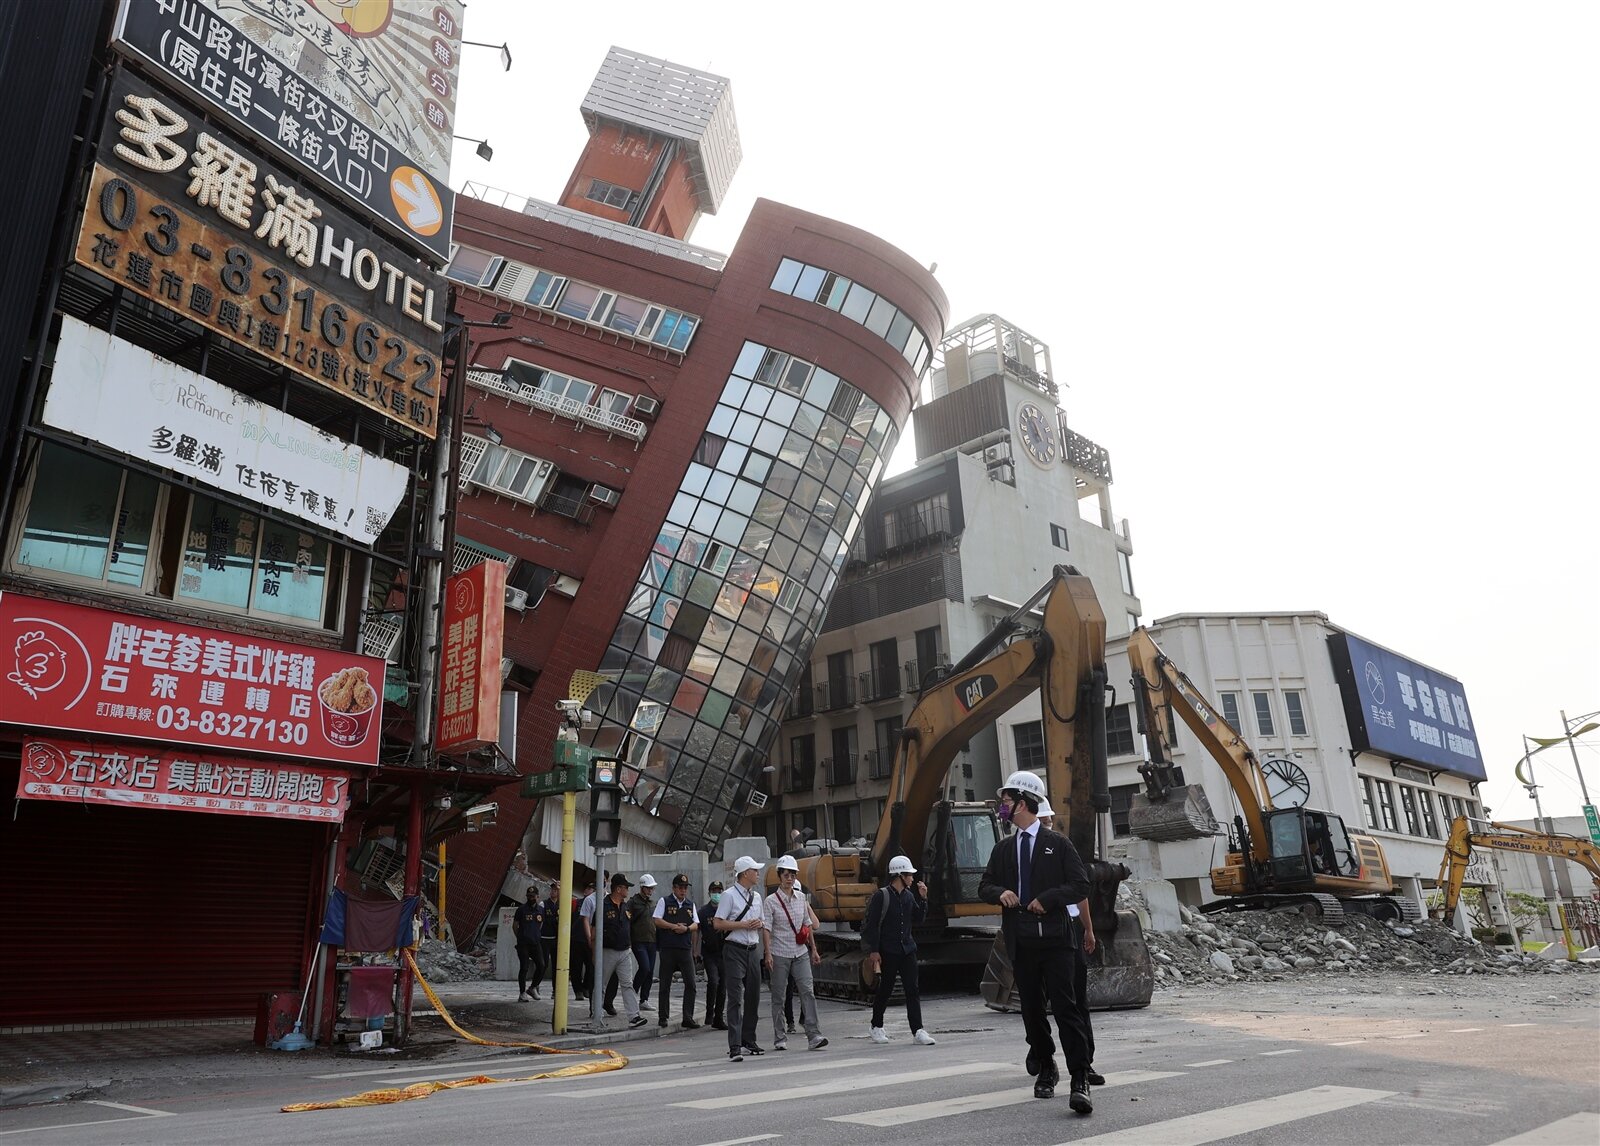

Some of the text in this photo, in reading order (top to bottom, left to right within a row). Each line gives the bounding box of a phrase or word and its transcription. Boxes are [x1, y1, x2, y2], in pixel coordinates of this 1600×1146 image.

[427, 11, 453, 129] 別無分號
[159, 29, 373, 199] (原住民一條街入口)
[100, 177, 437, 399] 03-8316622
[320, 224, 443, 333] HOTEL
[149, 425, 226, 477] 多羅滿
[235, 512, 255, 555] 骨飯
[105, 621, 316, 693] 胖老爹美式炸雞
[442, 621, 463, 717] 美式炸雞
[458, 613, 479, 713] 胖老爹
[966, 677, 984, 708] CAT
[1195, 702, 1210, 721] CAT
[156, 705, 309, 746] 03-8327130
[441, 711, 474, 741] 03-8327130
[68, 749, 349, 805] 石來店 集點活動開跑了
[1491, 840, 1530, 850] KOMATSU
